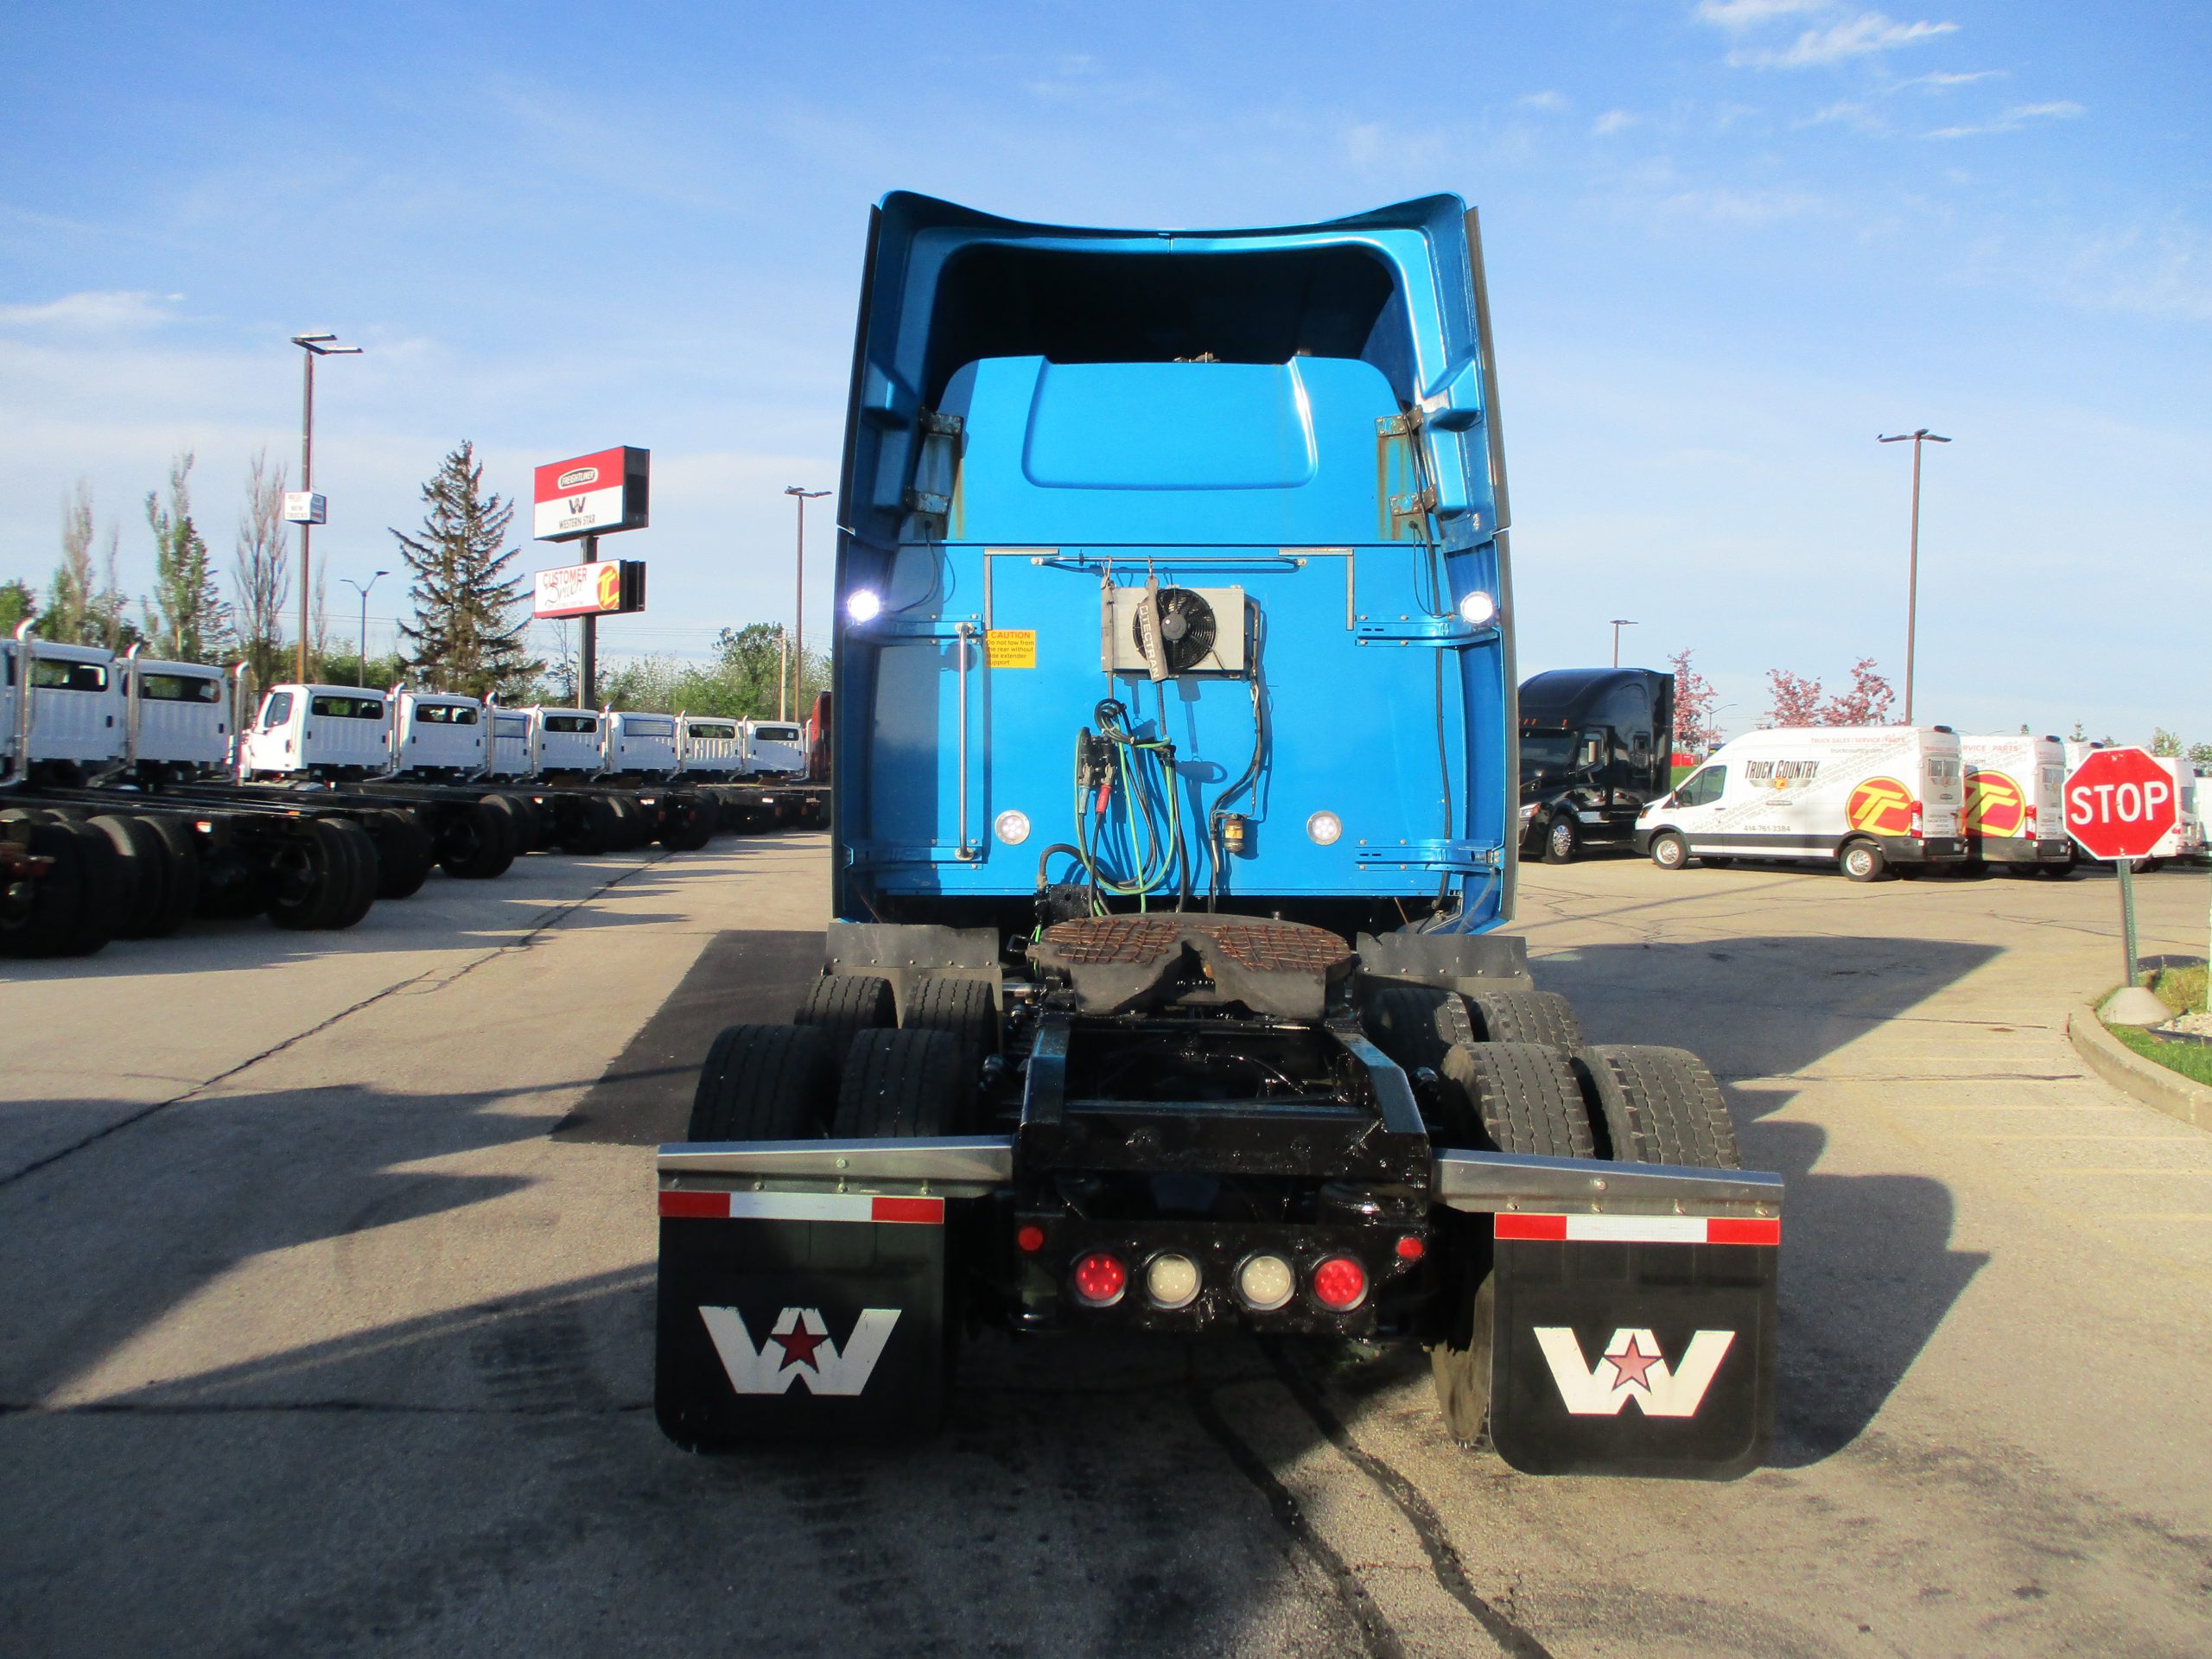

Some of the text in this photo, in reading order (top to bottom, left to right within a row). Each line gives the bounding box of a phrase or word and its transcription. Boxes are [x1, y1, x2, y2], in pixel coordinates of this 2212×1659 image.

[559, 514, 595, 530] WESTERN STAR
[543, 567, 588, 588] CUSTOMER
[1142, 614, 1160, 678] TECTRAN
[2070, 780, 2169, 825] STOP
